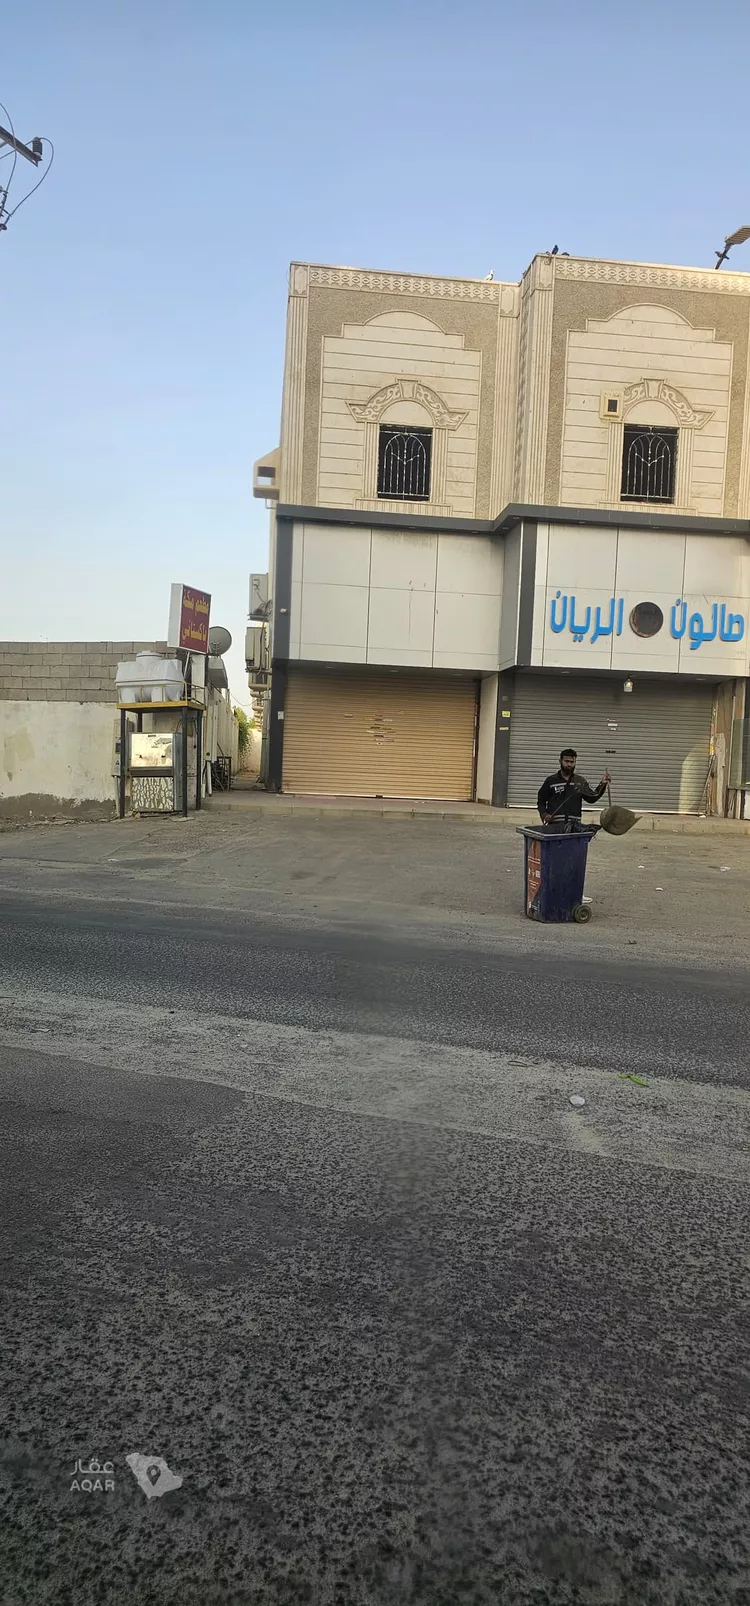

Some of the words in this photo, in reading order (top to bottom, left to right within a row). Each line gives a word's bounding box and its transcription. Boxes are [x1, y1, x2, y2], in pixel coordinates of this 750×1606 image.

[195, 596, 209, 616] مطعم
[550, 590, 624, 644] الريان
[670, 598, 745, 650] صالون
